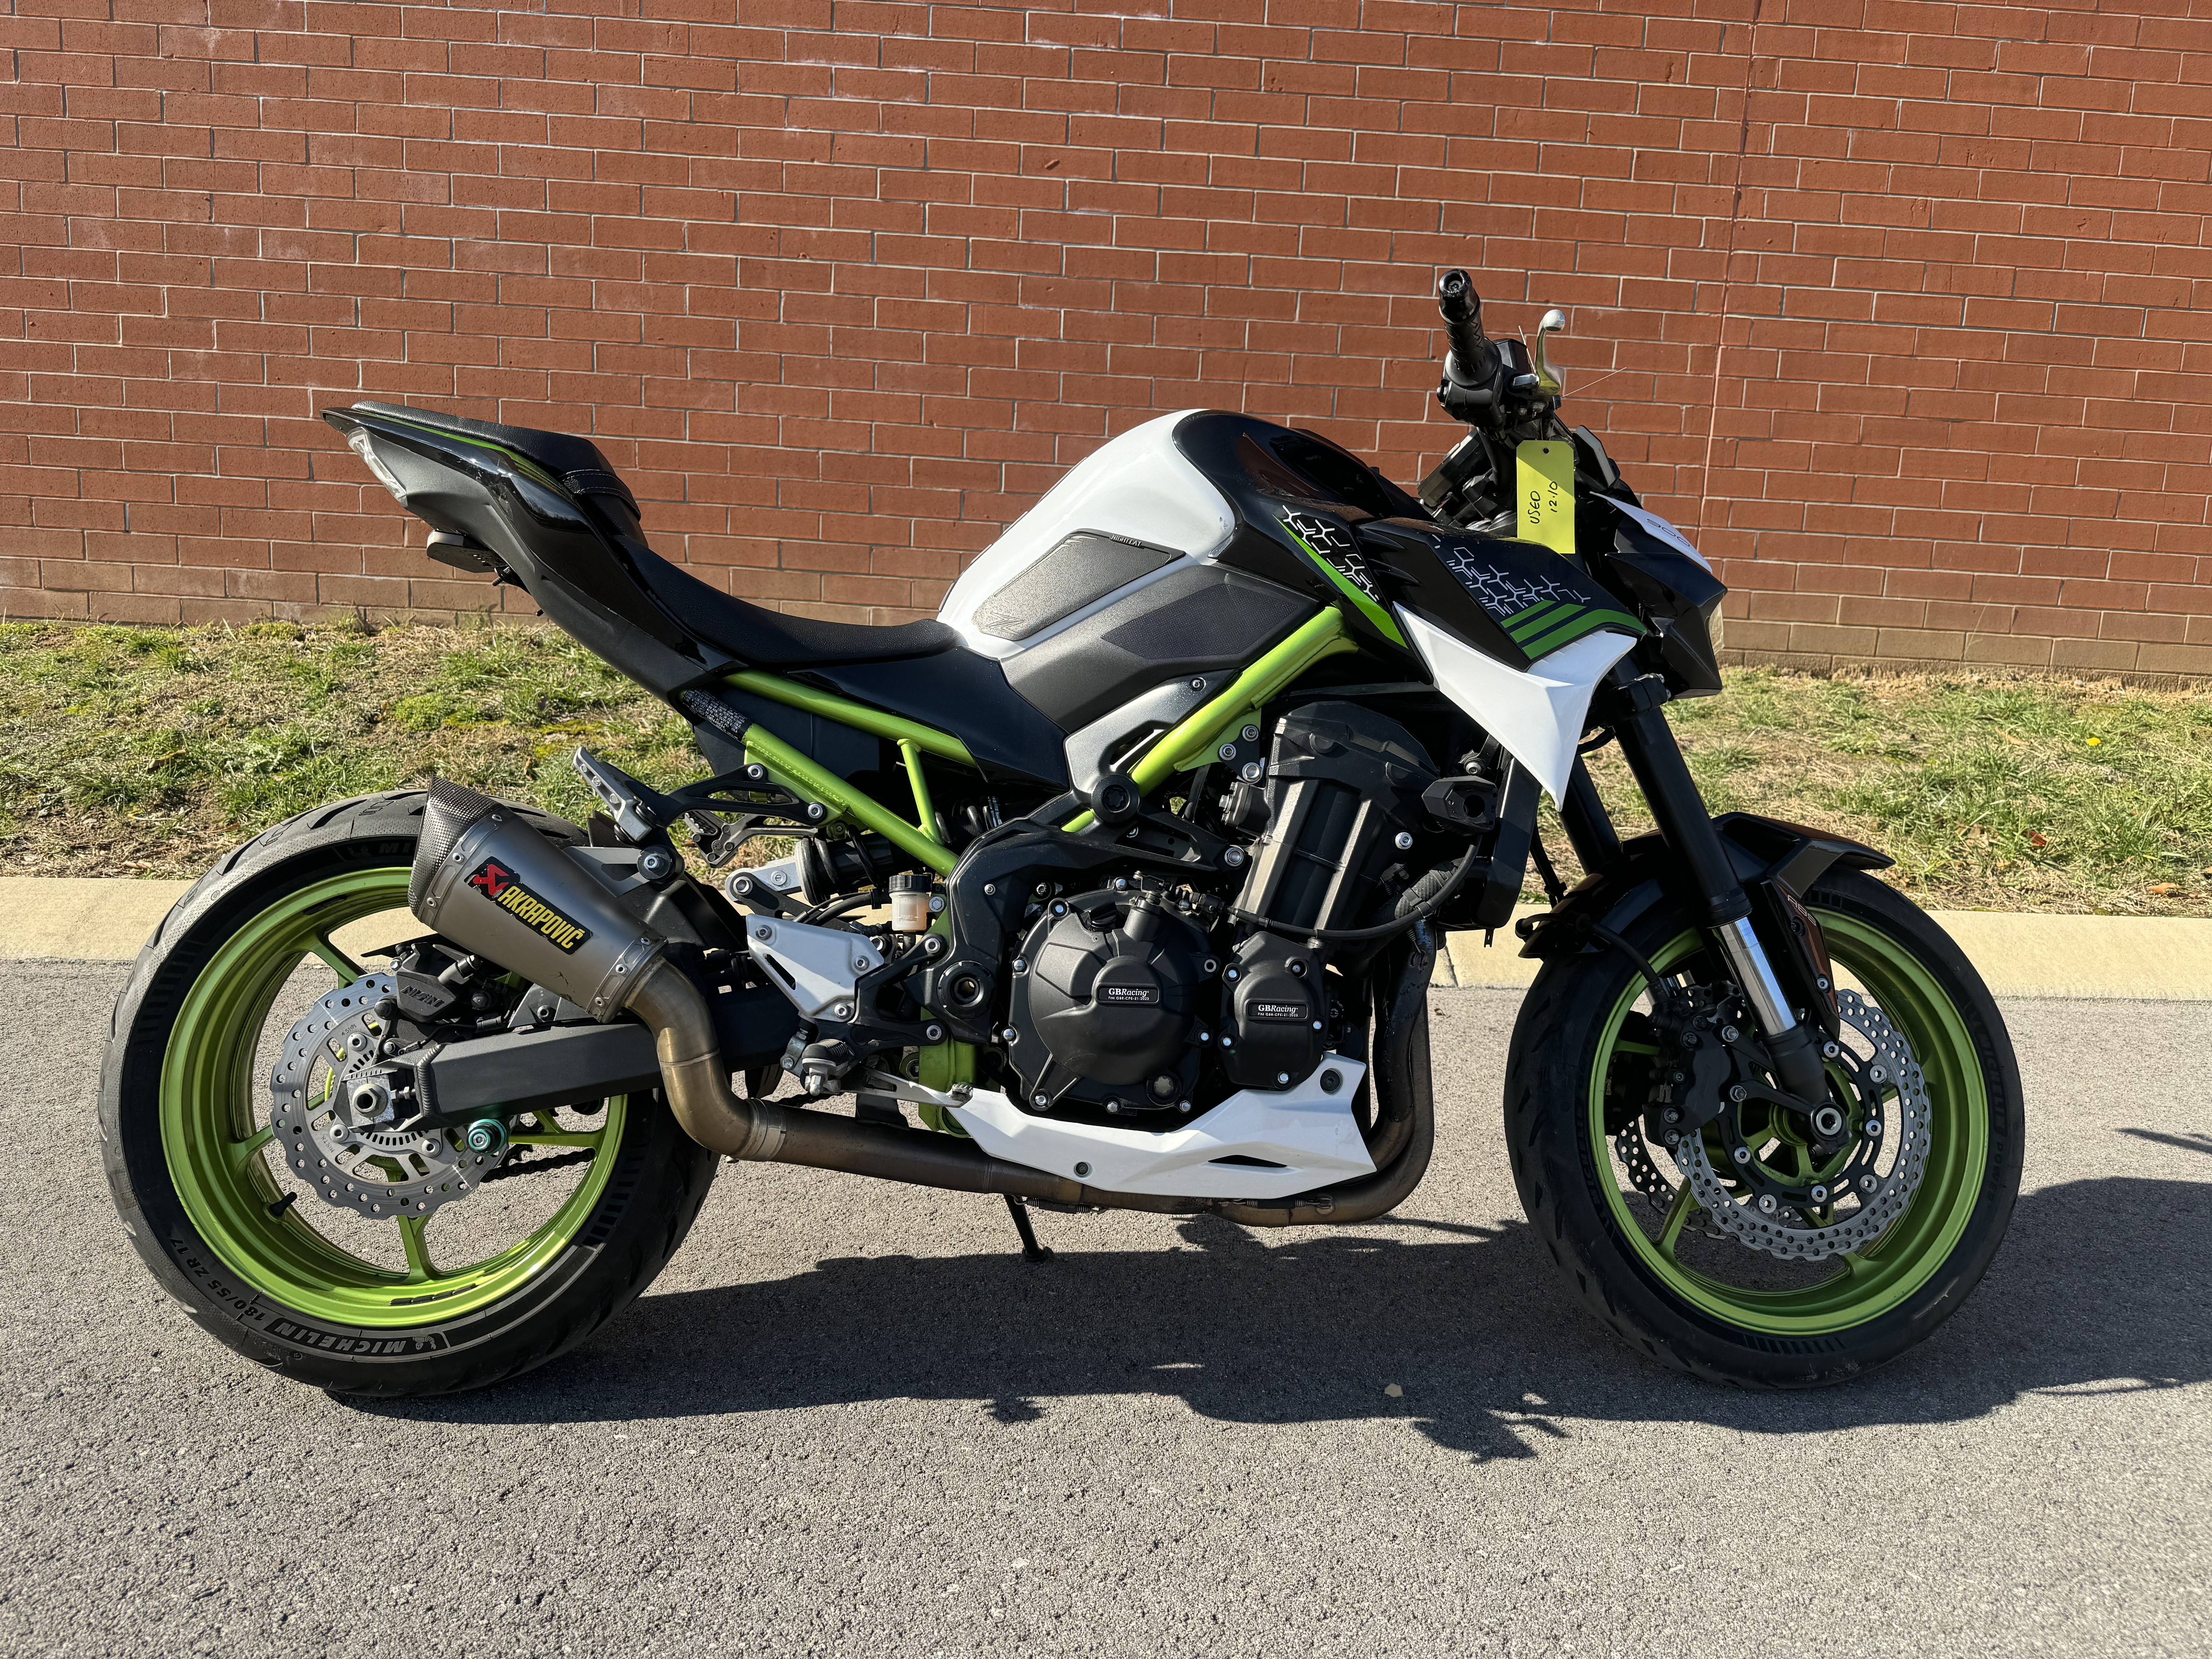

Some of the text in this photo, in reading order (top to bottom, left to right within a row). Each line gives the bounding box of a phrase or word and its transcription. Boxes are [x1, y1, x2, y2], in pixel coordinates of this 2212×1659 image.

[1528, 491, 1540, 524] USED
[1647, 519, 1690, 547] 900
[1787, 894, 1817, 927] ABS
[1108, 988, 1149, 997] GBRacing
[1257, 1004, 1298, 1013] GBRacing
[1976, 1033, 2006, 1202] MICHELIN POWER
[170, 1238, 266, 1321] 180/55 ZR 17
[274, 1322, 406, 1353] MICHELIN
